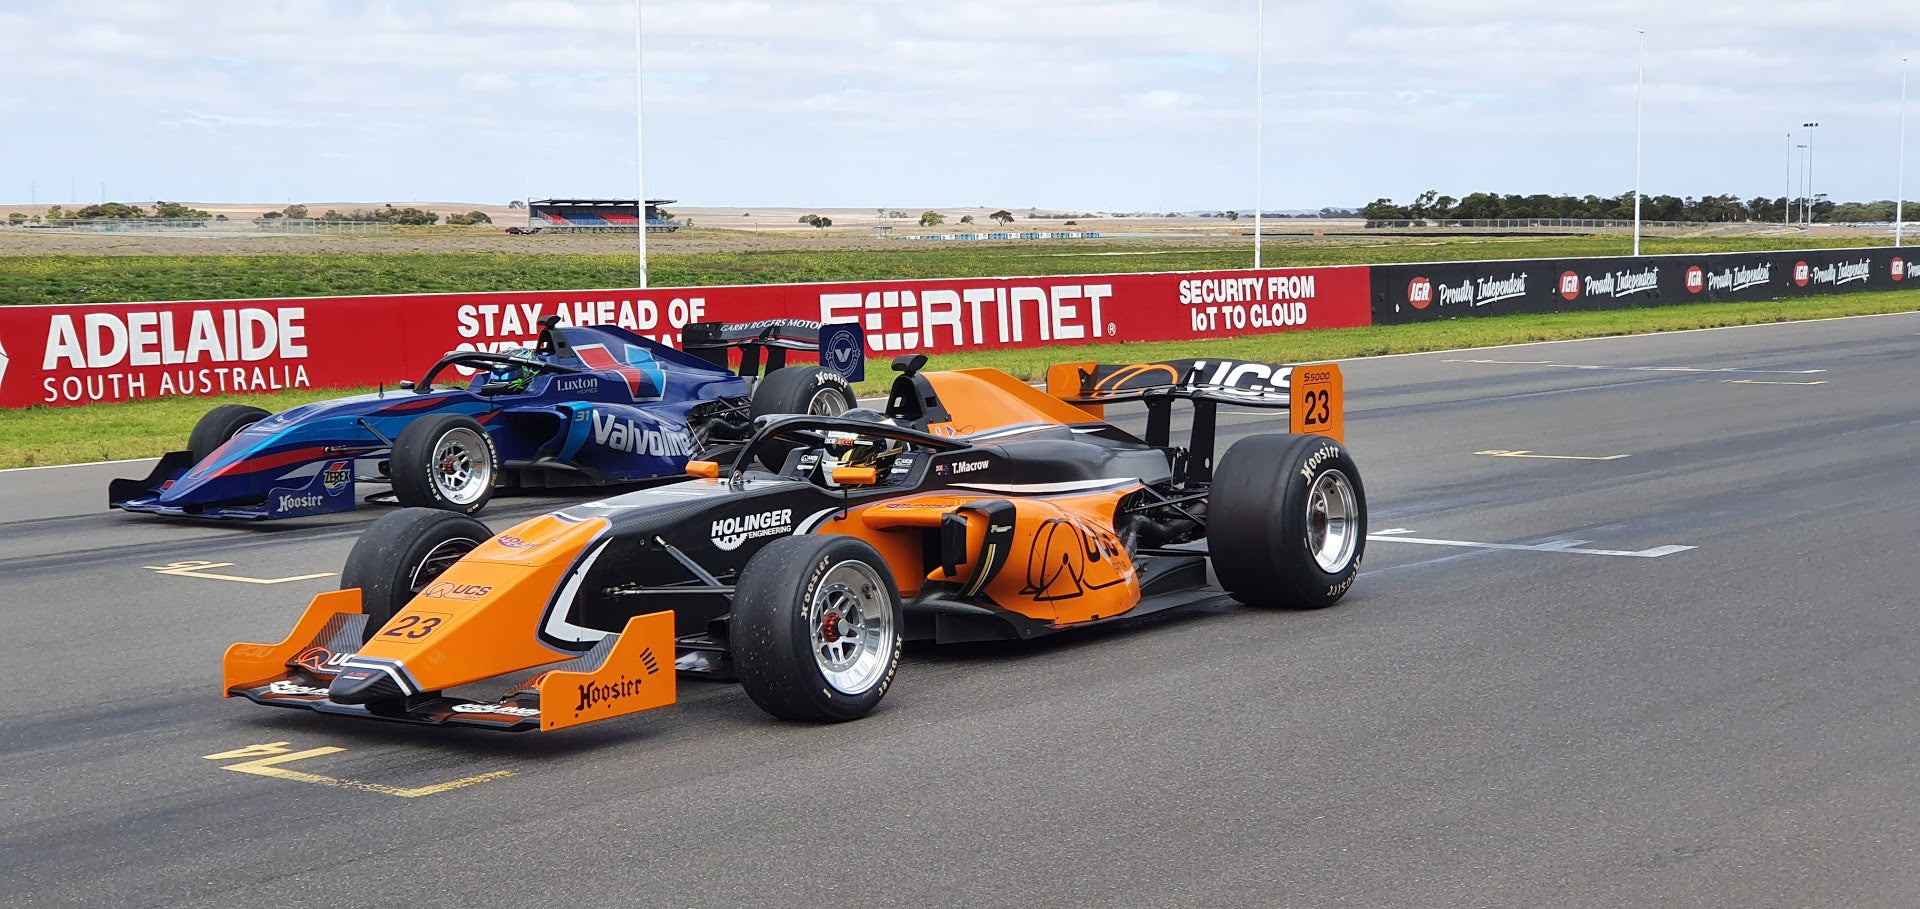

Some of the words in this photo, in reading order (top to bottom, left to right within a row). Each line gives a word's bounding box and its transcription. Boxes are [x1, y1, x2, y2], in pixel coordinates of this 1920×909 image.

[1561, 275, 1578, 293] IGA
[1584, 272, 1615, 298] Proudly
[1616, 266, 1659, 294] Independent
[1687, 270, 1702, 287] IGA
[1707, 268, 1733, 292] Proudly
[1733, 261, 1771, 287] Independent
[1795, 265, 1809, 281] IGA
[1812, 263, 1837, 286] Proudly
[1837, 258, 1871, 281] Independent
[1179, 277, 1264, 305] SECURITY
[1267, 275, 1316, 301] FROM
[1410, 282, 1430, 302] IGA
[1438, 279, 1474, 307] Proudly
[1476, 271, 1528, 302] Independent
[457, 303, 543, 338] STAY
[555, 299, 658, 330] AHEAD
[667, 298, 706, 330] OF
[720, 322, 748, 332] GARRY
[750, 318, 786, 330] ROGERS
[819, 283, 1113, 351] FORTINET
[1191, 307, 1217, 332] IoT
[1221, 305, 1246, 330] TO
[1249, 302, 1307, 328] CLOUD
[41, 307, 309, 371] ADELAIDE
[43, 372, 146, 402] SOUTH
[159, 364, 310, 397] AUSTRALIA
[557, 377, 598, 392] Luxton
[814, 371, 848, 389] Hoosier
[1303, 372, 1331, 382] S5000
[574, 410, 591, 422] 31
[1304, 389, 1330, 426] 23
[592, 409, 695, 457] Valvoline
[324, 470, 350, 484] ZEREX
[951, 459, 990, 475] T.Macrow
[1300, 442, 1340, 486] Hoosier
[276, 492, 324, 513] Hoosier
[710, 508, 792, 538] HOLINGER
[748, 525, 792, 540] ENGINEERING
[452, 583, 493, 597] UCS
[800, 555, 830, 621] Hoosier
[382, 615, 442, 640] 23
[327, 652, 357, 667] UC
[575, 674, 643, 711] Hoosier
